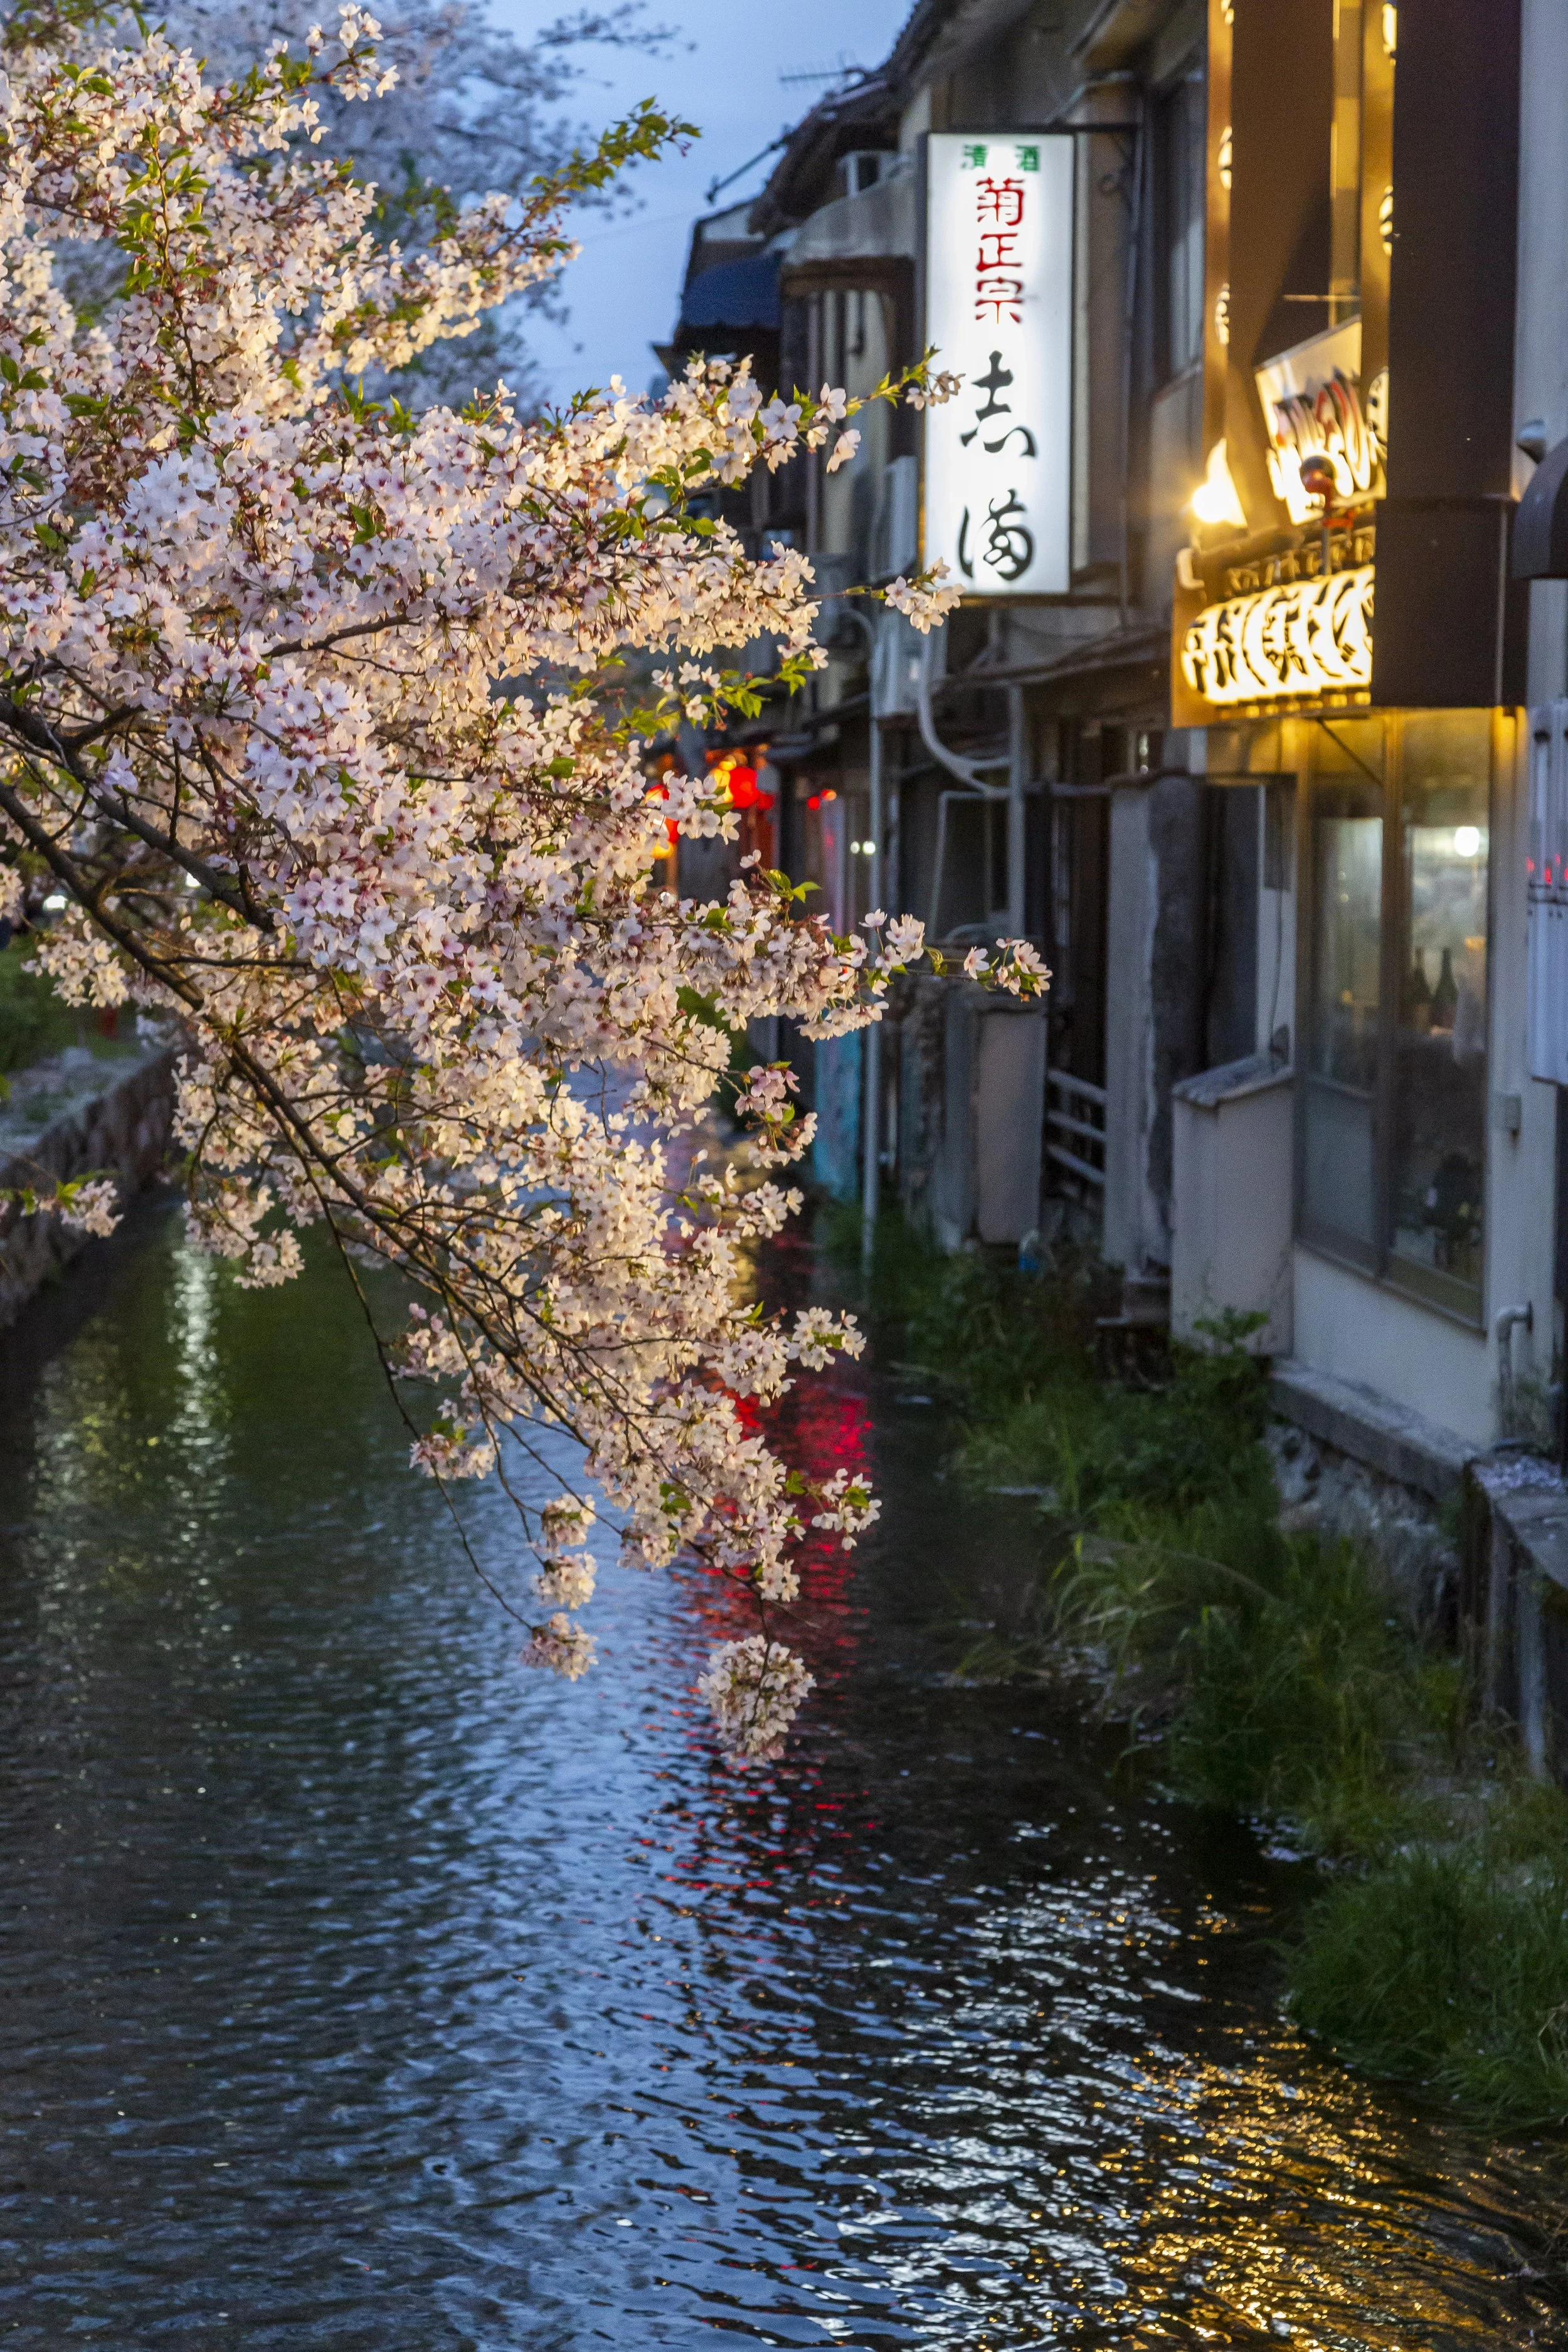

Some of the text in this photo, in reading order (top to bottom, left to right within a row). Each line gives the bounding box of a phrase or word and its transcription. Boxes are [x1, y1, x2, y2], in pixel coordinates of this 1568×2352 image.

[961, 144, 1039, 171] 清酒
[975, 176, 1024, 324] 菊正宗
